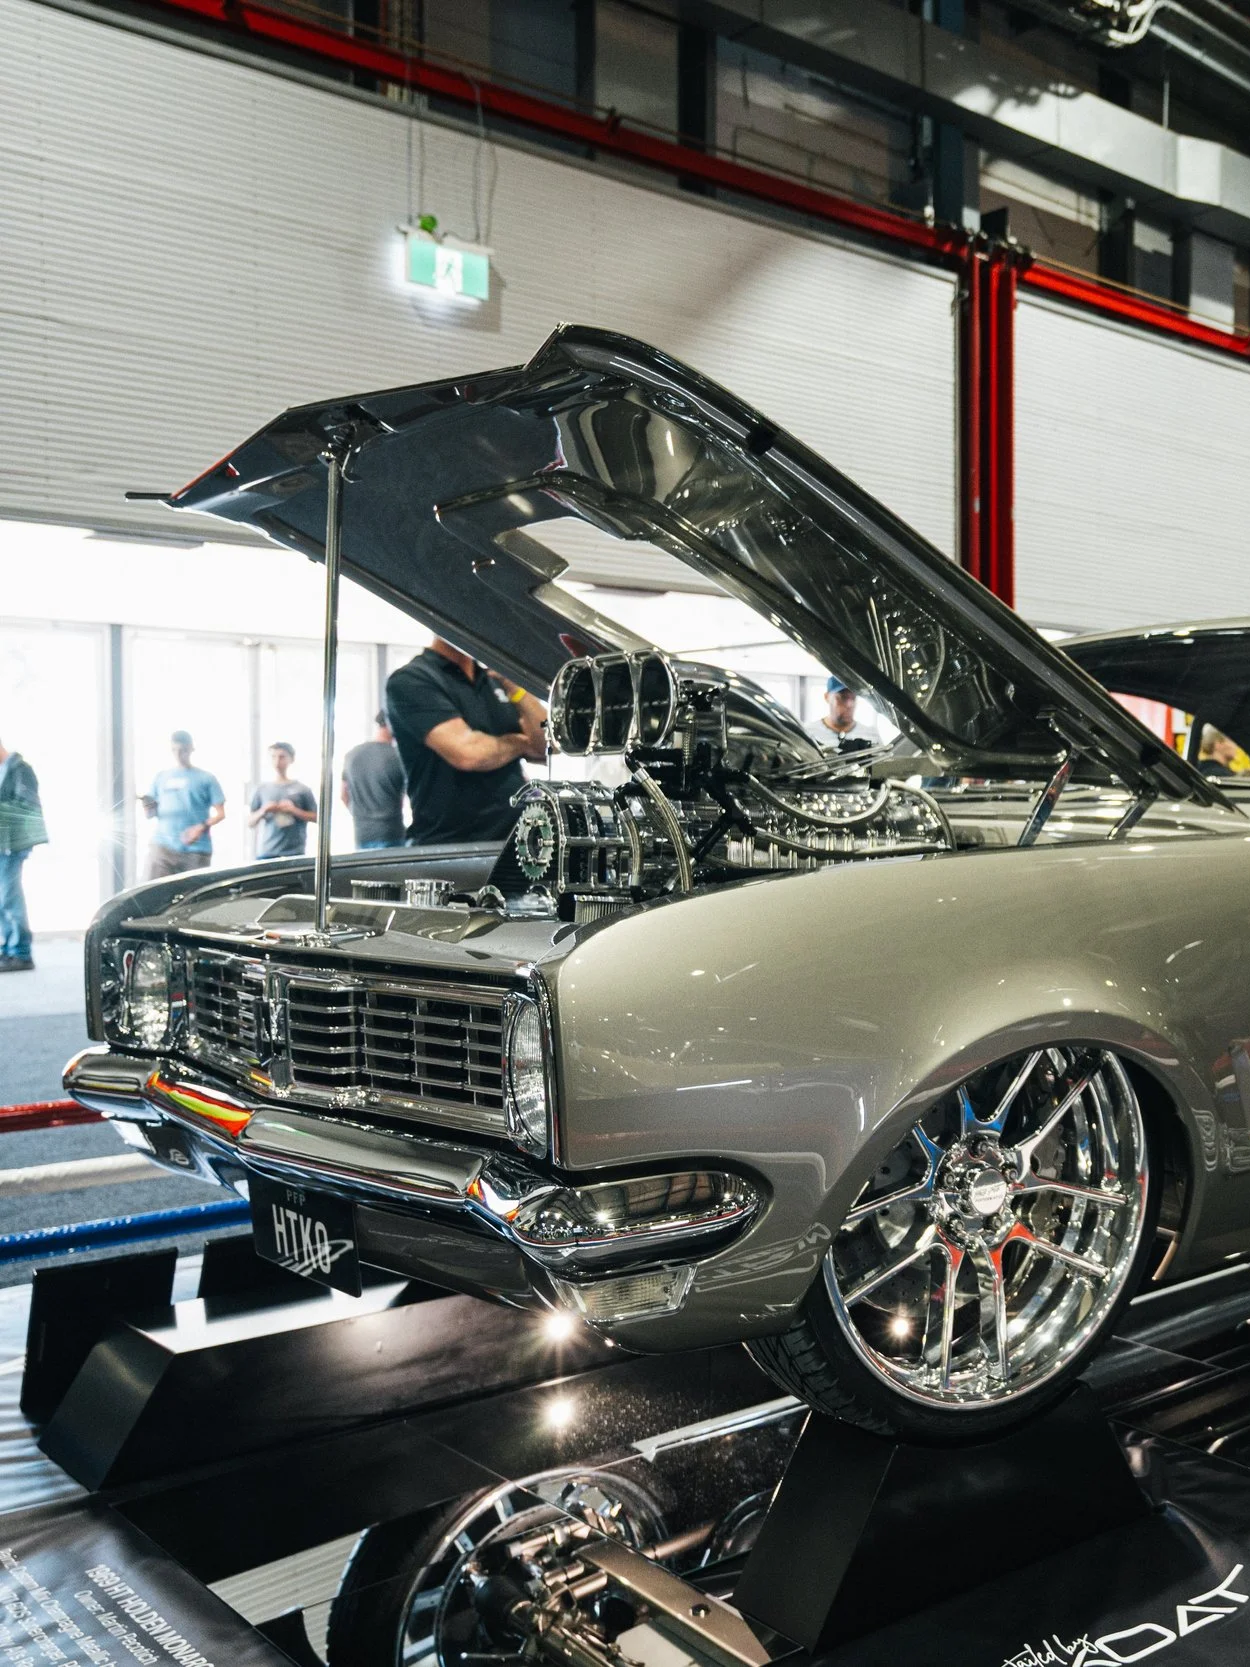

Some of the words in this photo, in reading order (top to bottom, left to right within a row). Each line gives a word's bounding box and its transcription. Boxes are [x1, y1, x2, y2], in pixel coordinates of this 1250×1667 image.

[104, 1582, 135, 1600] HT
[117, 1594, 172, 1636] HOLDEN
[152, 1629, 214, 1667] MONAR
[1052, 1633, 1099, 1656] by
